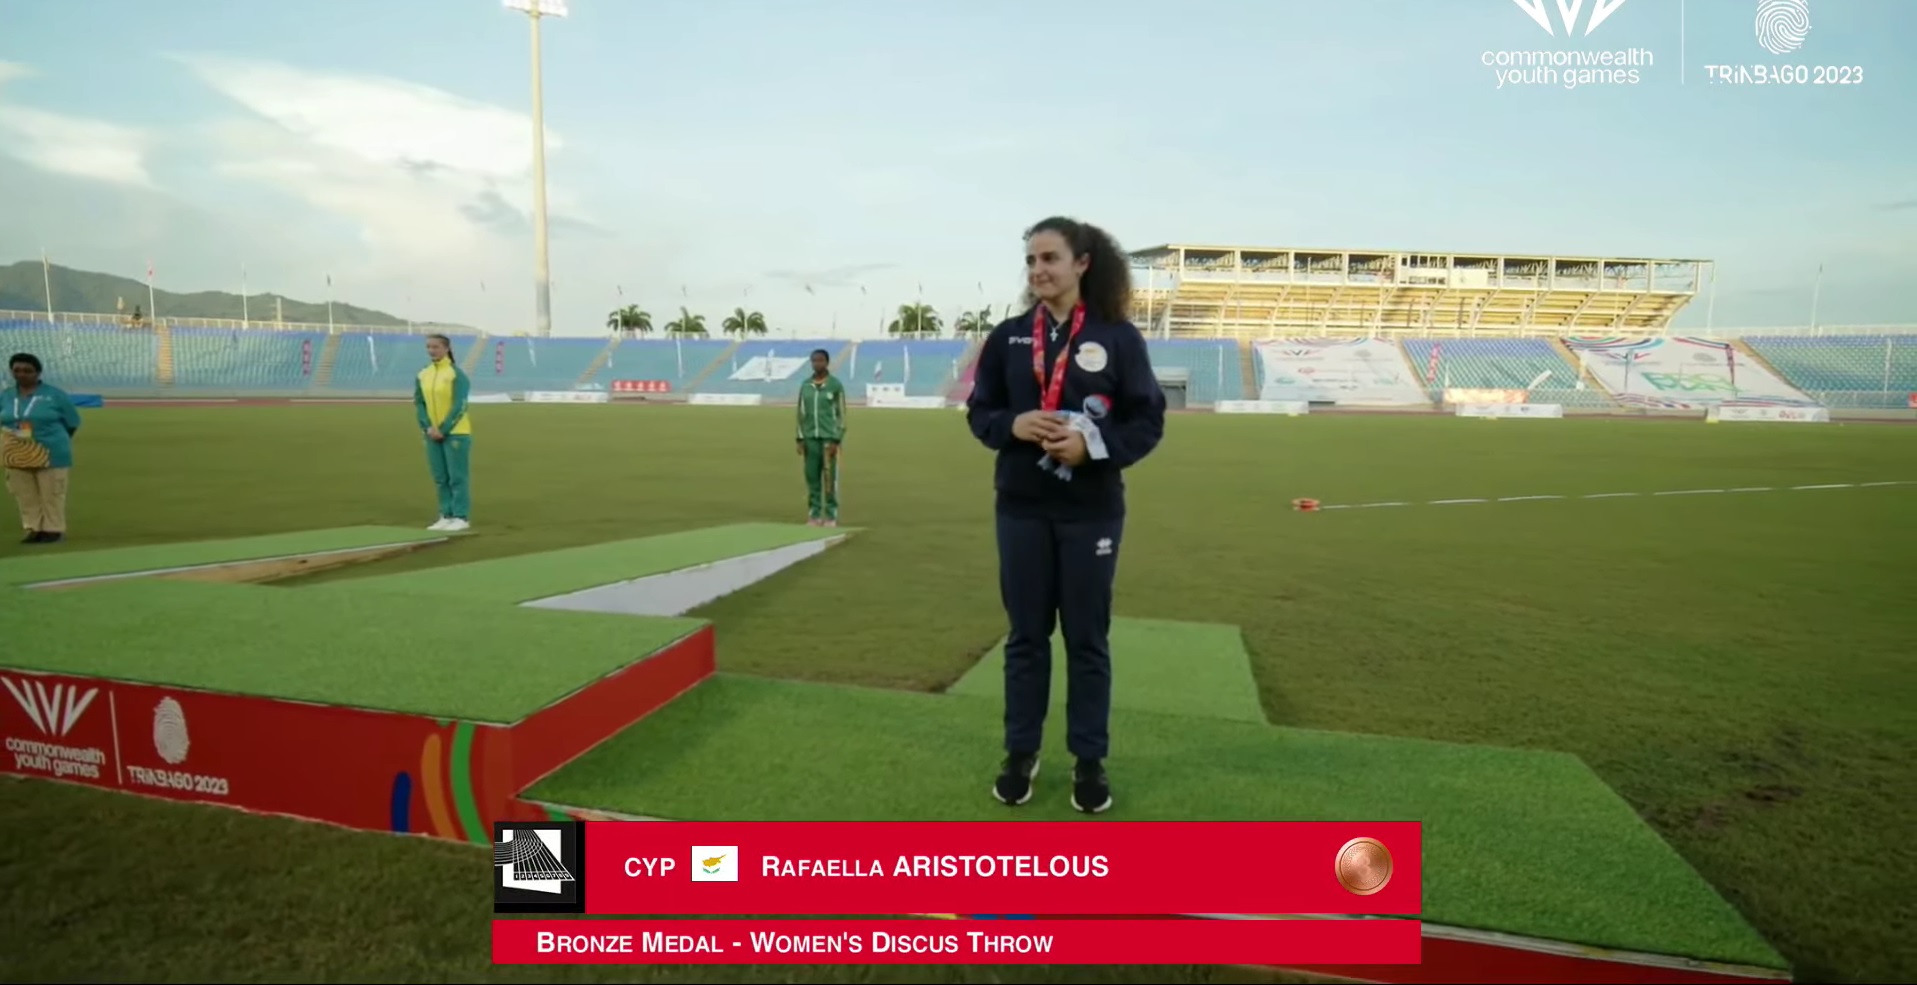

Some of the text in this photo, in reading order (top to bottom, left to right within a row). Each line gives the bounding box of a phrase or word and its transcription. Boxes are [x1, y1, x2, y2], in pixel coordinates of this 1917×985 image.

[5, 737, 106, 765] commonwealth
[15, 753, 100, 778] youth games
[195, 776, 229, 795] 2023
